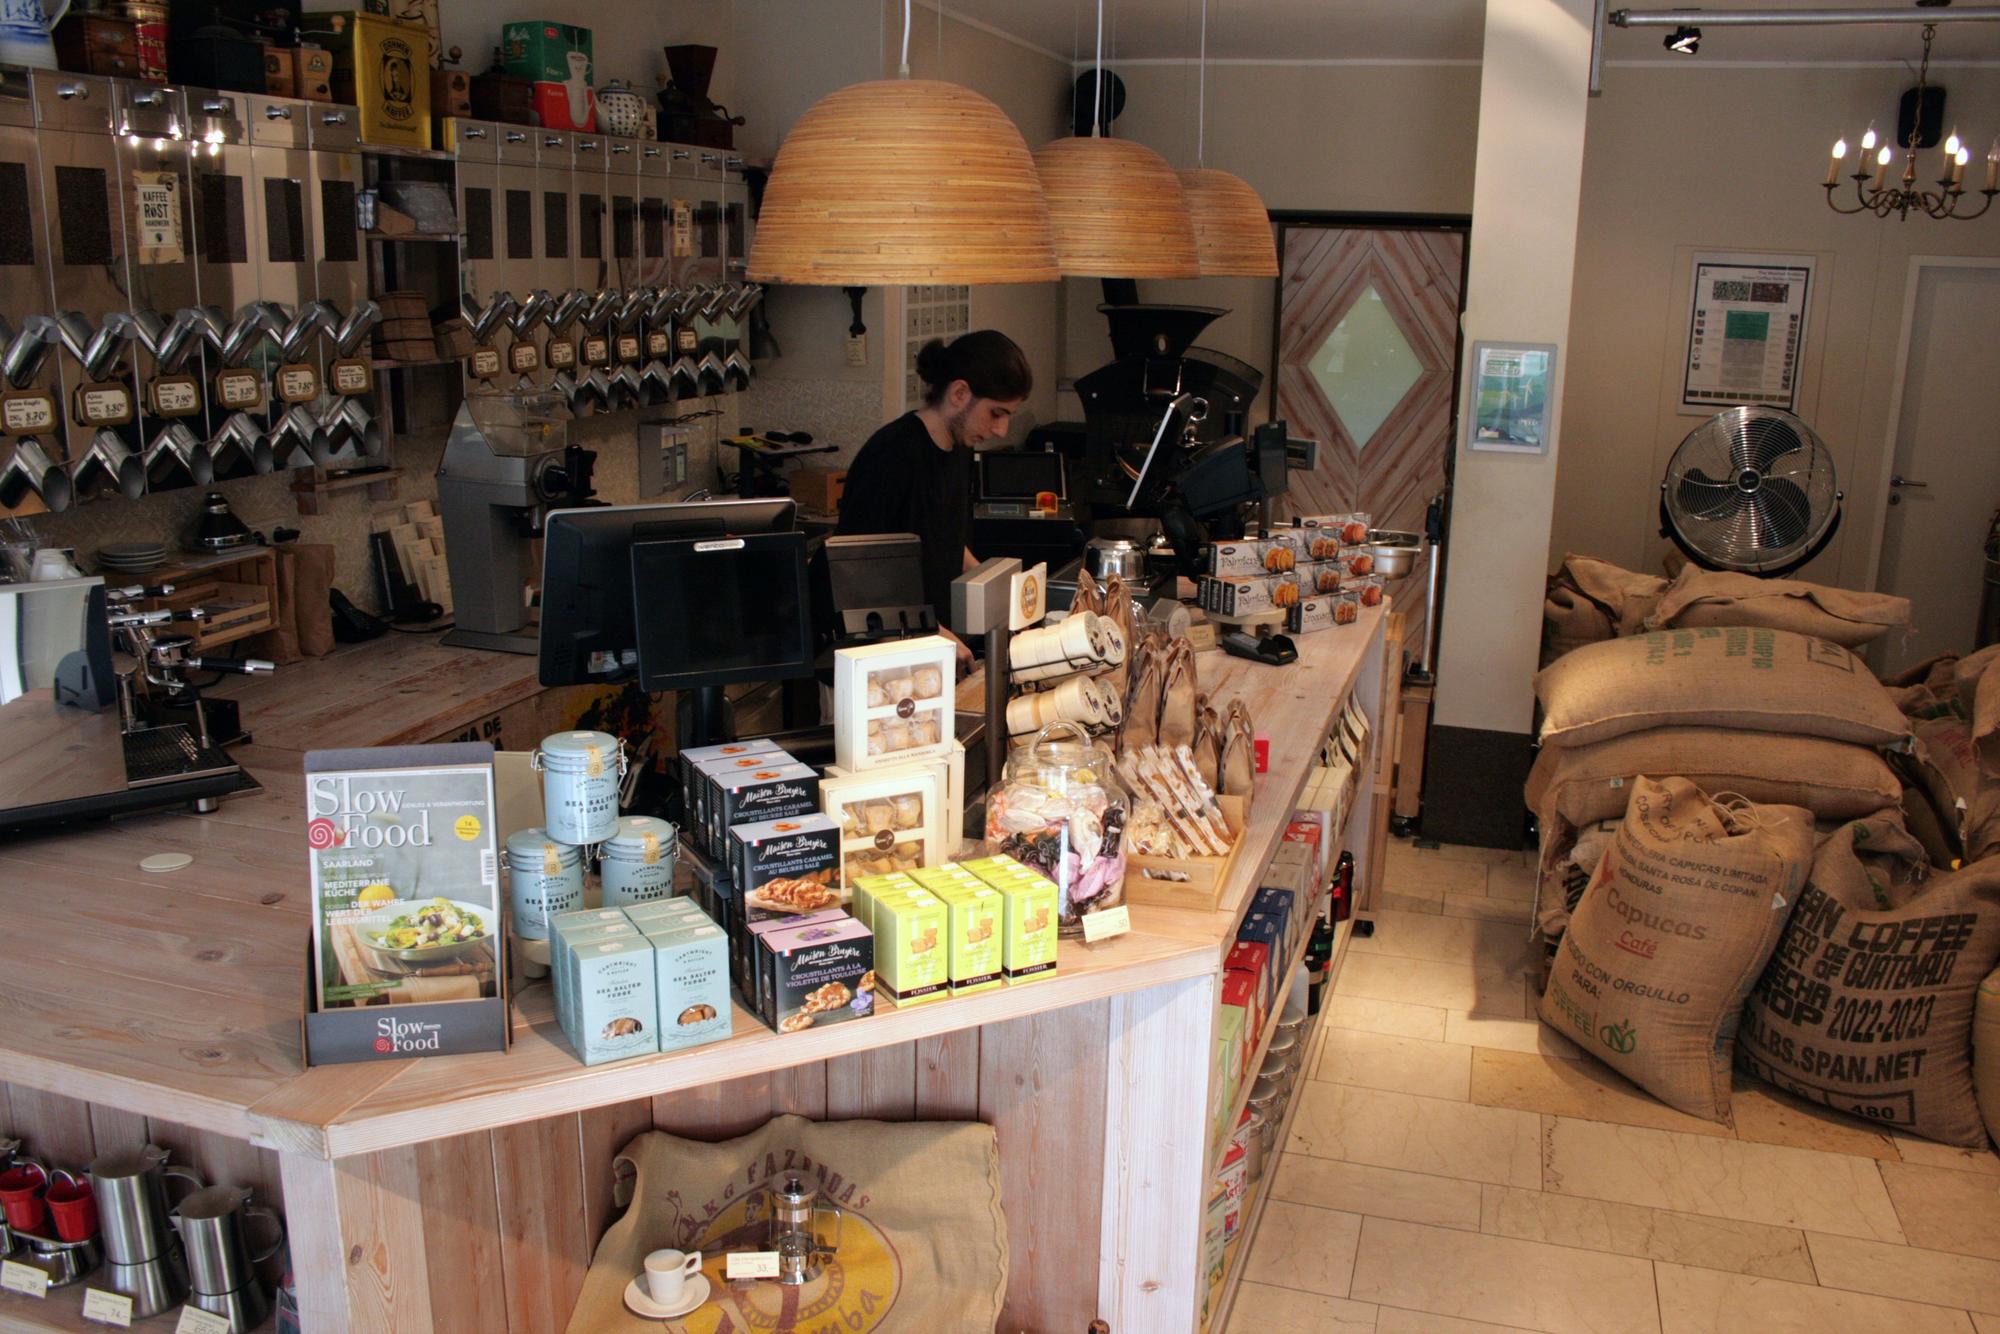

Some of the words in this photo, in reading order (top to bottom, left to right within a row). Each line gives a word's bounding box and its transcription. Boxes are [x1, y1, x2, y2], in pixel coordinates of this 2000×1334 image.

[143, 191, 168, 202] KAFFEE
[483, 716, 500, 738] DE
[314, 776, 405, 815] Slow
[739, 788, 773, 809] Maison
[580, 804, 609, 814] FUDGE
[733, 806, 783, 819] CROUSTILLANTS
[783, 801, 814, 811] CARAMEL
[759, 812, 784, 821] BEURRE
[339, 809, 431, 850] Food
[759, 840, 793, 862] Maison
[323, 859, 374, 869] SAARLAND
[753, 858, 803, 872] CROUSTILLANTS
[803, 853, 834, 863] CARAMEL
[778, 864, 804, 874] BEURRE
[804, 861, 820, 870] SALÉ
[1669, 858, 1721, 875] CAPUCAS
[1723, 868, 1768, 885] LIMITADA
[324, 878, 391, 889] MEDITERRANE
[1618, 864, 1664, 896] HONDURAS
[1638, 861, 1669, 881] SANTA
[1671, 873, 1702, 888] ROSA
[1703, 879, 1719, 890] DE
[324, 888, 358, 898] KÜCHE
[634, 890, 663, 900] FUDGE
[351, 900, 370, 909] DER
[538, 902, 570, 912] FUDGE
[1606, 887, 1709, 941] Capucas
[1619, 930, 1659, 956] Café
[1848, 912, 1979, 954] COFFEE
[790, 950, 826, 972] Maison
[1823, 942, 1851, 967] DE
[690, 969, 716, 979] SALTED
[786, 976, 820, 988] VIOLETTE
[830, 967, 867, 980] TOULOUSE
[791, 965, 846, 981] CROUSTILLANTS
[852, 962, 862, 970] LA
[1813, 960, 1843, 981] OF
[1843, 951, 1958, 990] GUATEMALA
[614, 982, 641, 992] SALTED
[683, 977, 706, 986] FUDGE
[1572, 968, 1602, 1000] PARA:
[1586, 962, 1612, 984] CON
[1613, 978, 1690, 1005] ORGULLO
[607, 990, 631, 999] FUDGE
[377, 1017, 424, 1037] Slow
[392, 1031, 440, 1052] Food
[1850, 1104, 1895, 1120] 480
[747, 1149, 871, 1210] FAZENDAS
